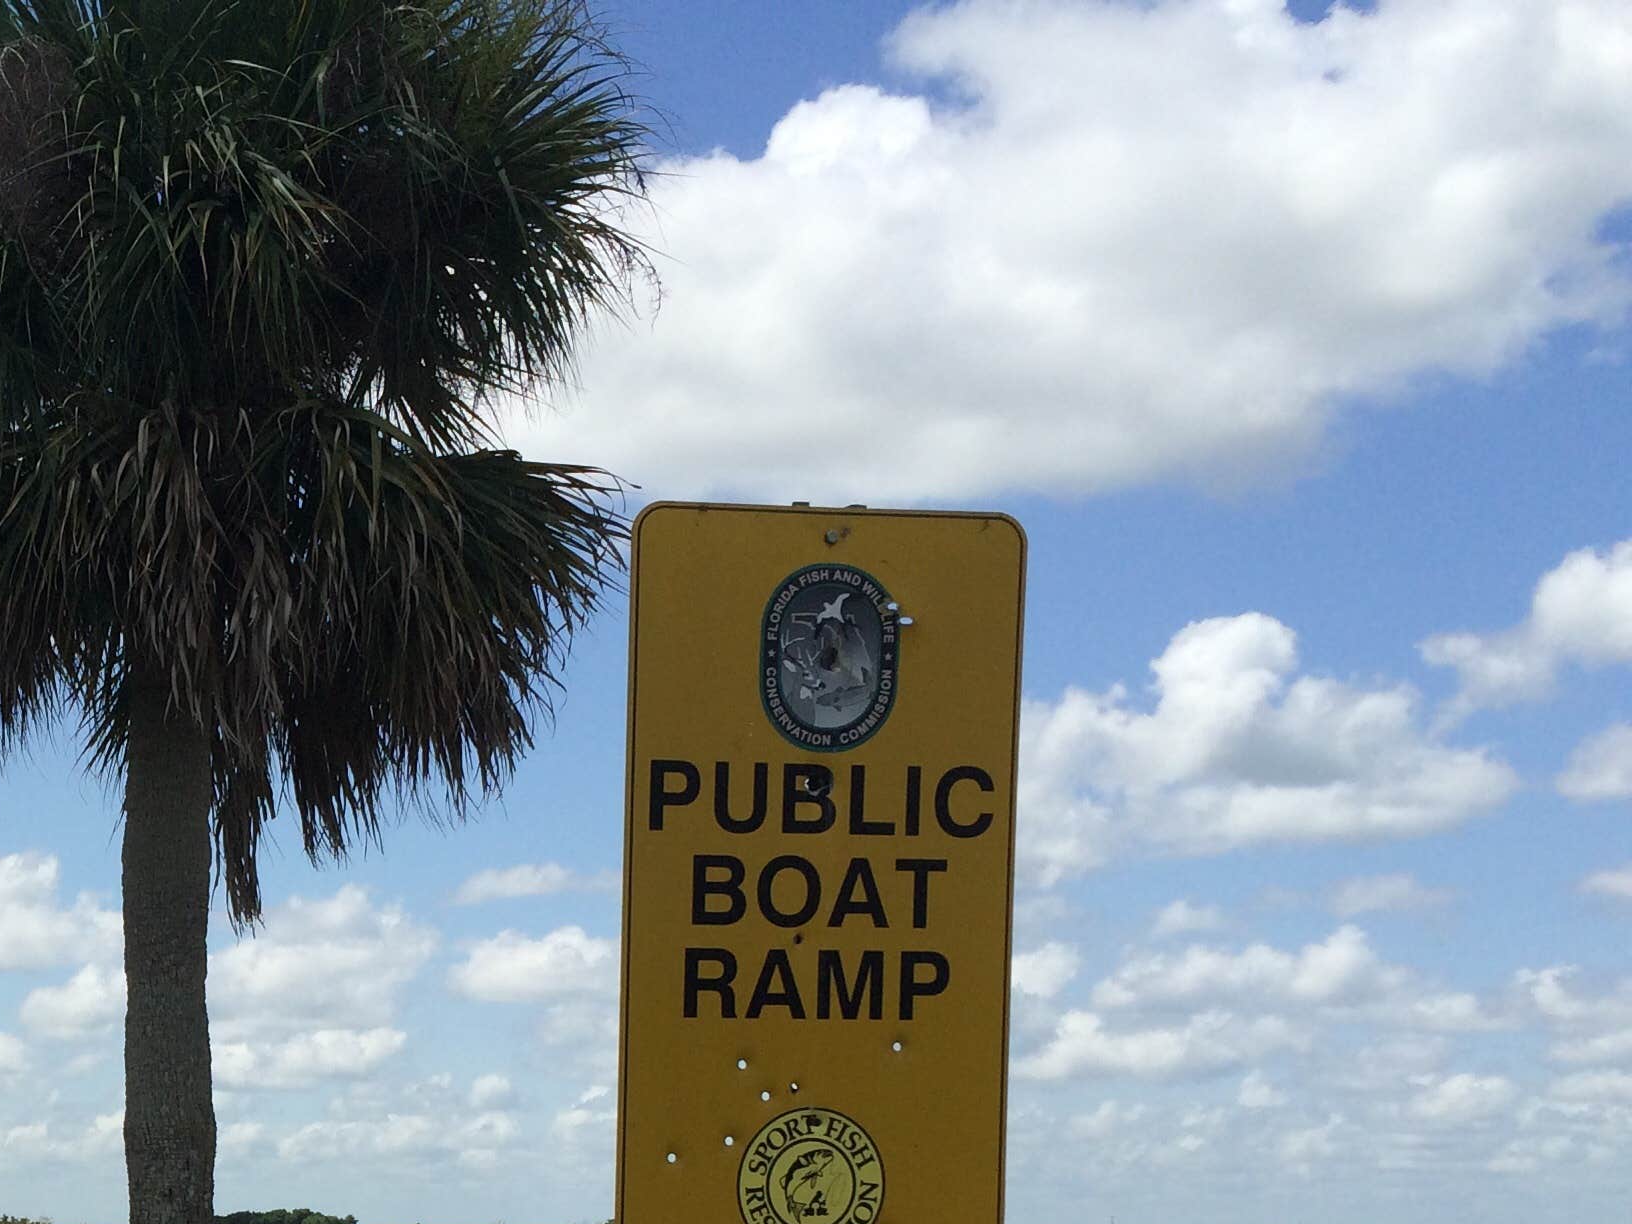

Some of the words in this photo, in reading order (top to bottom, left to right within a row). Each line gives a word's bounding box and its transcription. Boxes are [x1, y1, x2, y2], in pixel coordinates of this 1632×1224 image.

[768, 583, 800, 640] FLORIDA
[799, 569, 829, 587] FISH
[833, 570, 861, 586] AND
[766, 666, 832, 746] CONSERVATION
[839, 669, 892, 744] COMMISSION
[648, 759, 996, 838] PUBLIC
[691, 854, 948, 929] BOAT
[683, 947, 951, 1021] RAMP
[748, 1114, 818, 1177] SPORT
[824, 1117, 876, 1170] FISH
